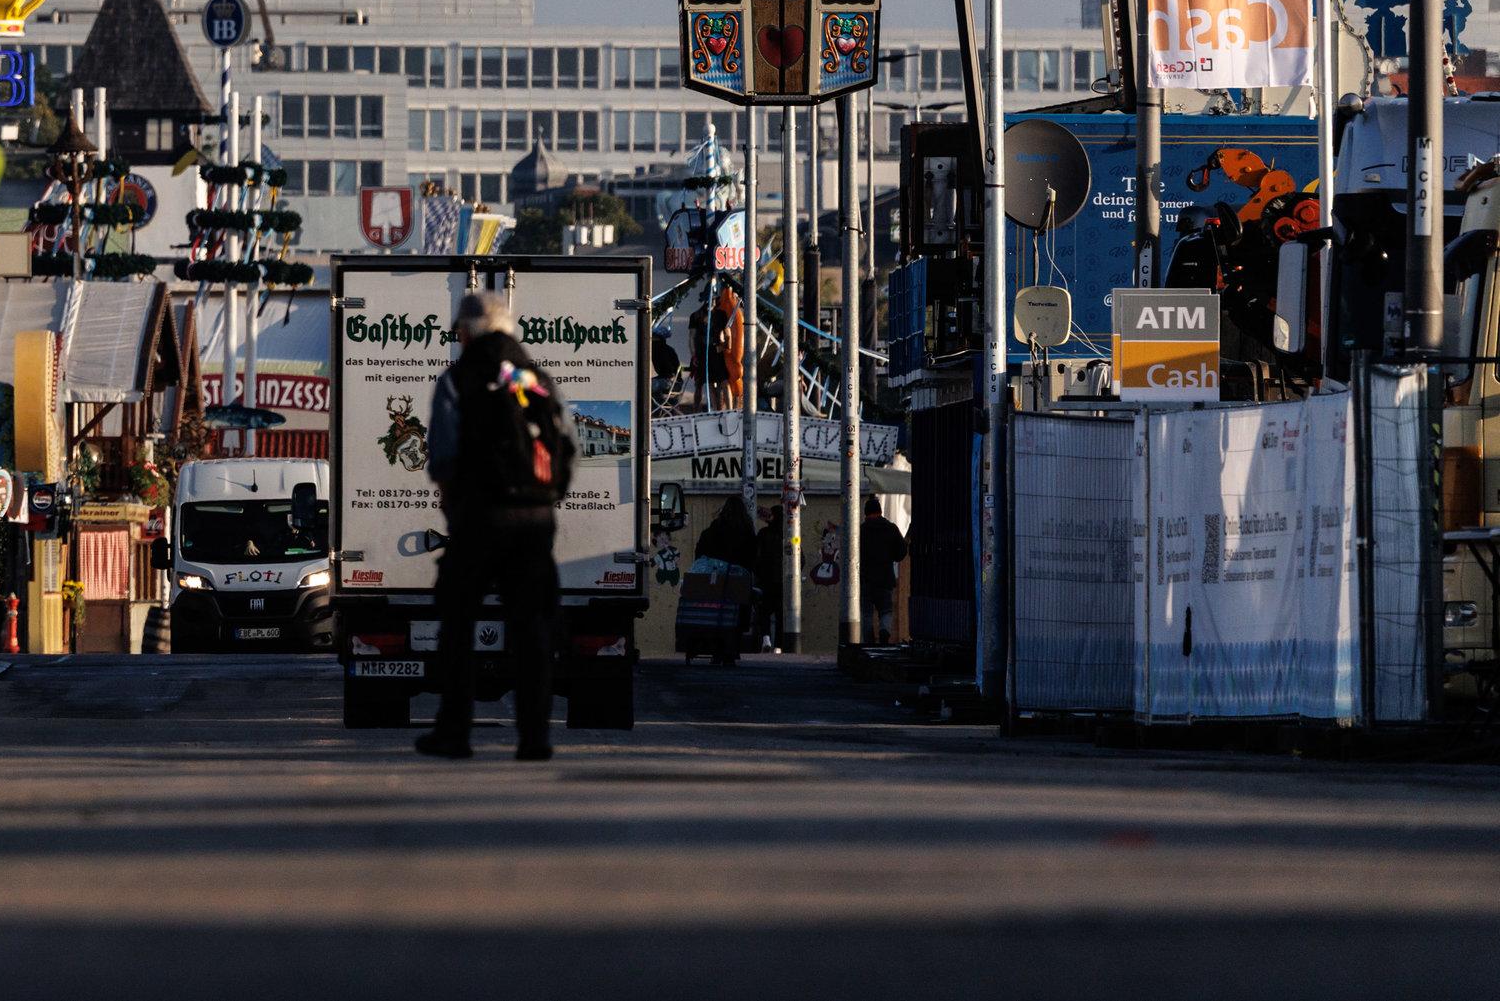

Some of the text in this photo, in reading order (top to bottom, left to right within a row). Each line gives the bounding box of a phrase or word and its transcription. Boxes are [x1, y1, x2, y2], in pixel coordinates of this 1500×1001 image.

[212, 19, 237, 41] HB
[1102, 207, 1125, 219] und
[1141, 240, 1151, 288] M-C0
[1136, 306, 1206, 330] ATM
[518, 315, 628, 353] Wildpark
[345, 357, 364, 367] das
[367, 357, 424, 368] bayerische
[533, 358, 561, 368] üden
[586, 358, 634, 368] München
[365, 374, 383, 382] mit
[385, 374, 426, 384] eigener
[1147, 364, 1218, 389] Cash
[355, 489, 376, 498] Tel:
[378, 489, 430, 498] 08170-99
[603, 490, 611, 499] 2
[351, 500, 373, 509] Fax:
[376, 500, 428, 509] 08170-99
[565, 501, 616, 511] Straßlach
[388, 662, 420, 675] 9282
